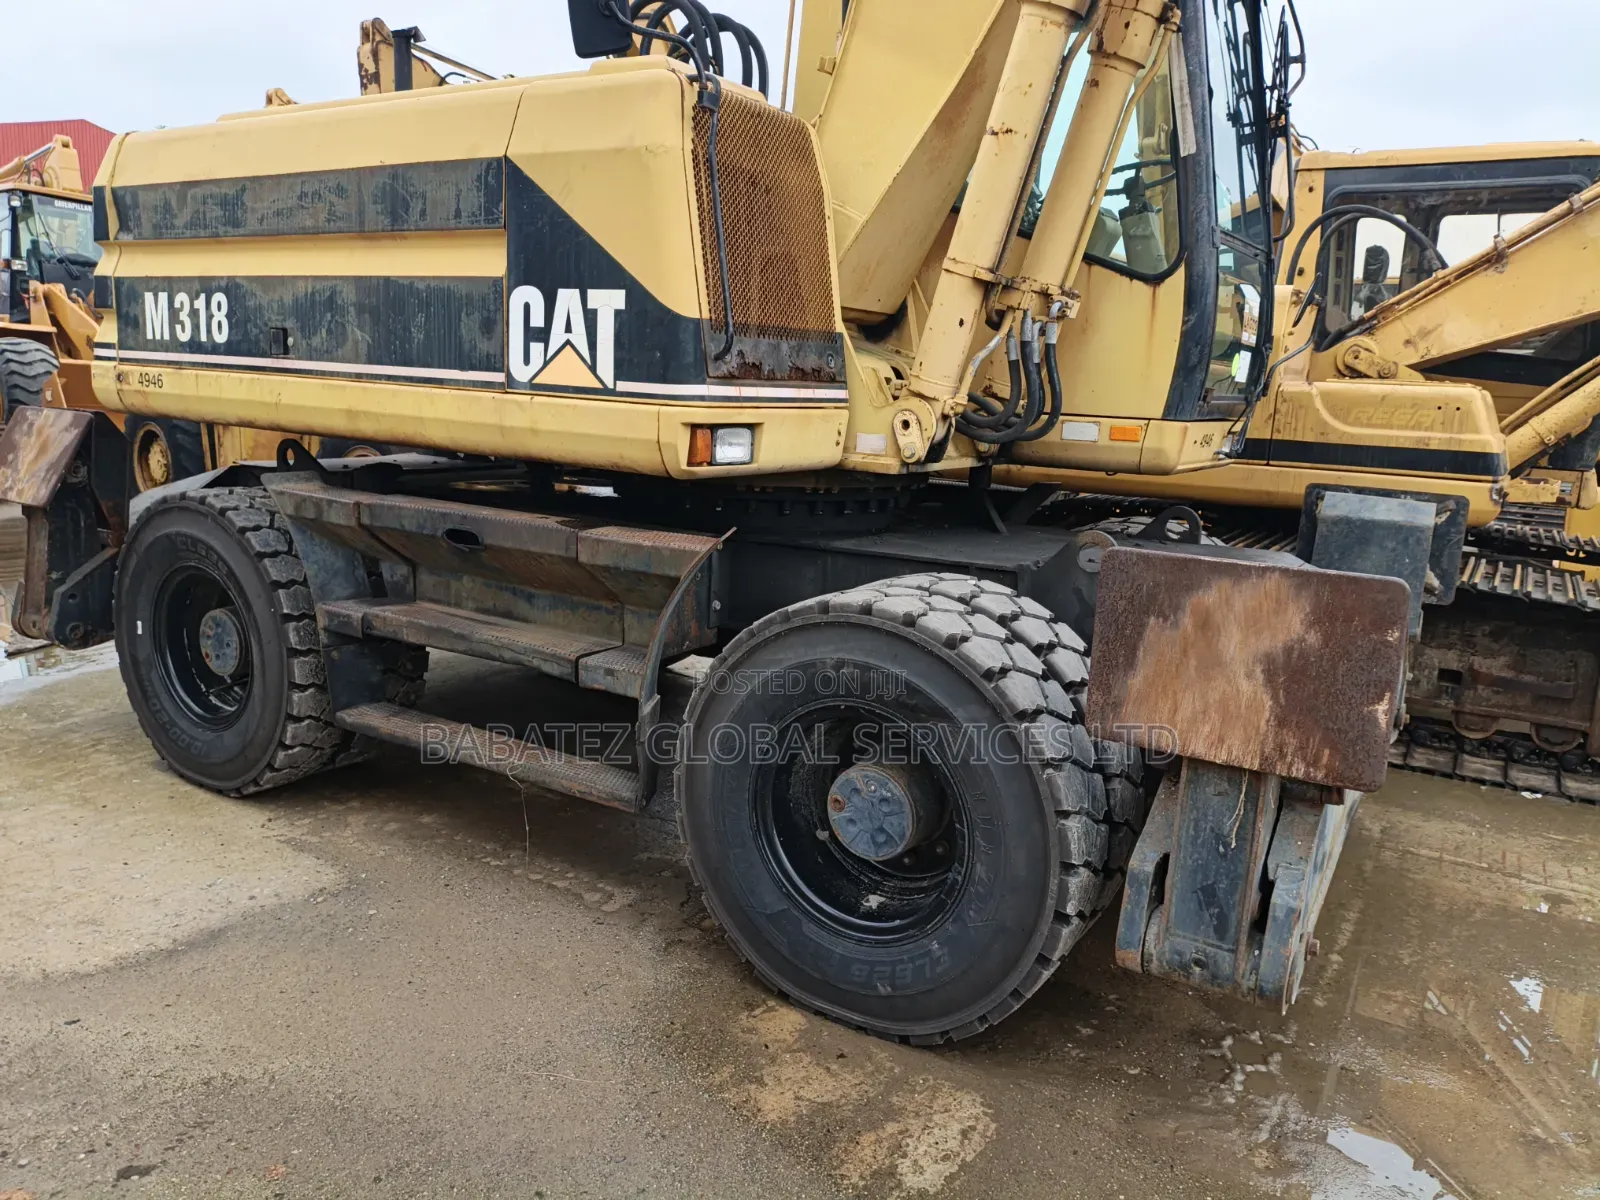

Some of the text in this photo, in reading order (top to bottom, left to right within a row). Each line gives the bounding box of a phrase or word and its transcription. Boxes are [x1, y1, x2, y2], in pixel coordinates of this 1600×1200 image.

[54, 199, 93, 212] CATERPILLAR
[508, 284, 626, 389] CAT
[137, 372, 164, 389] 4946
